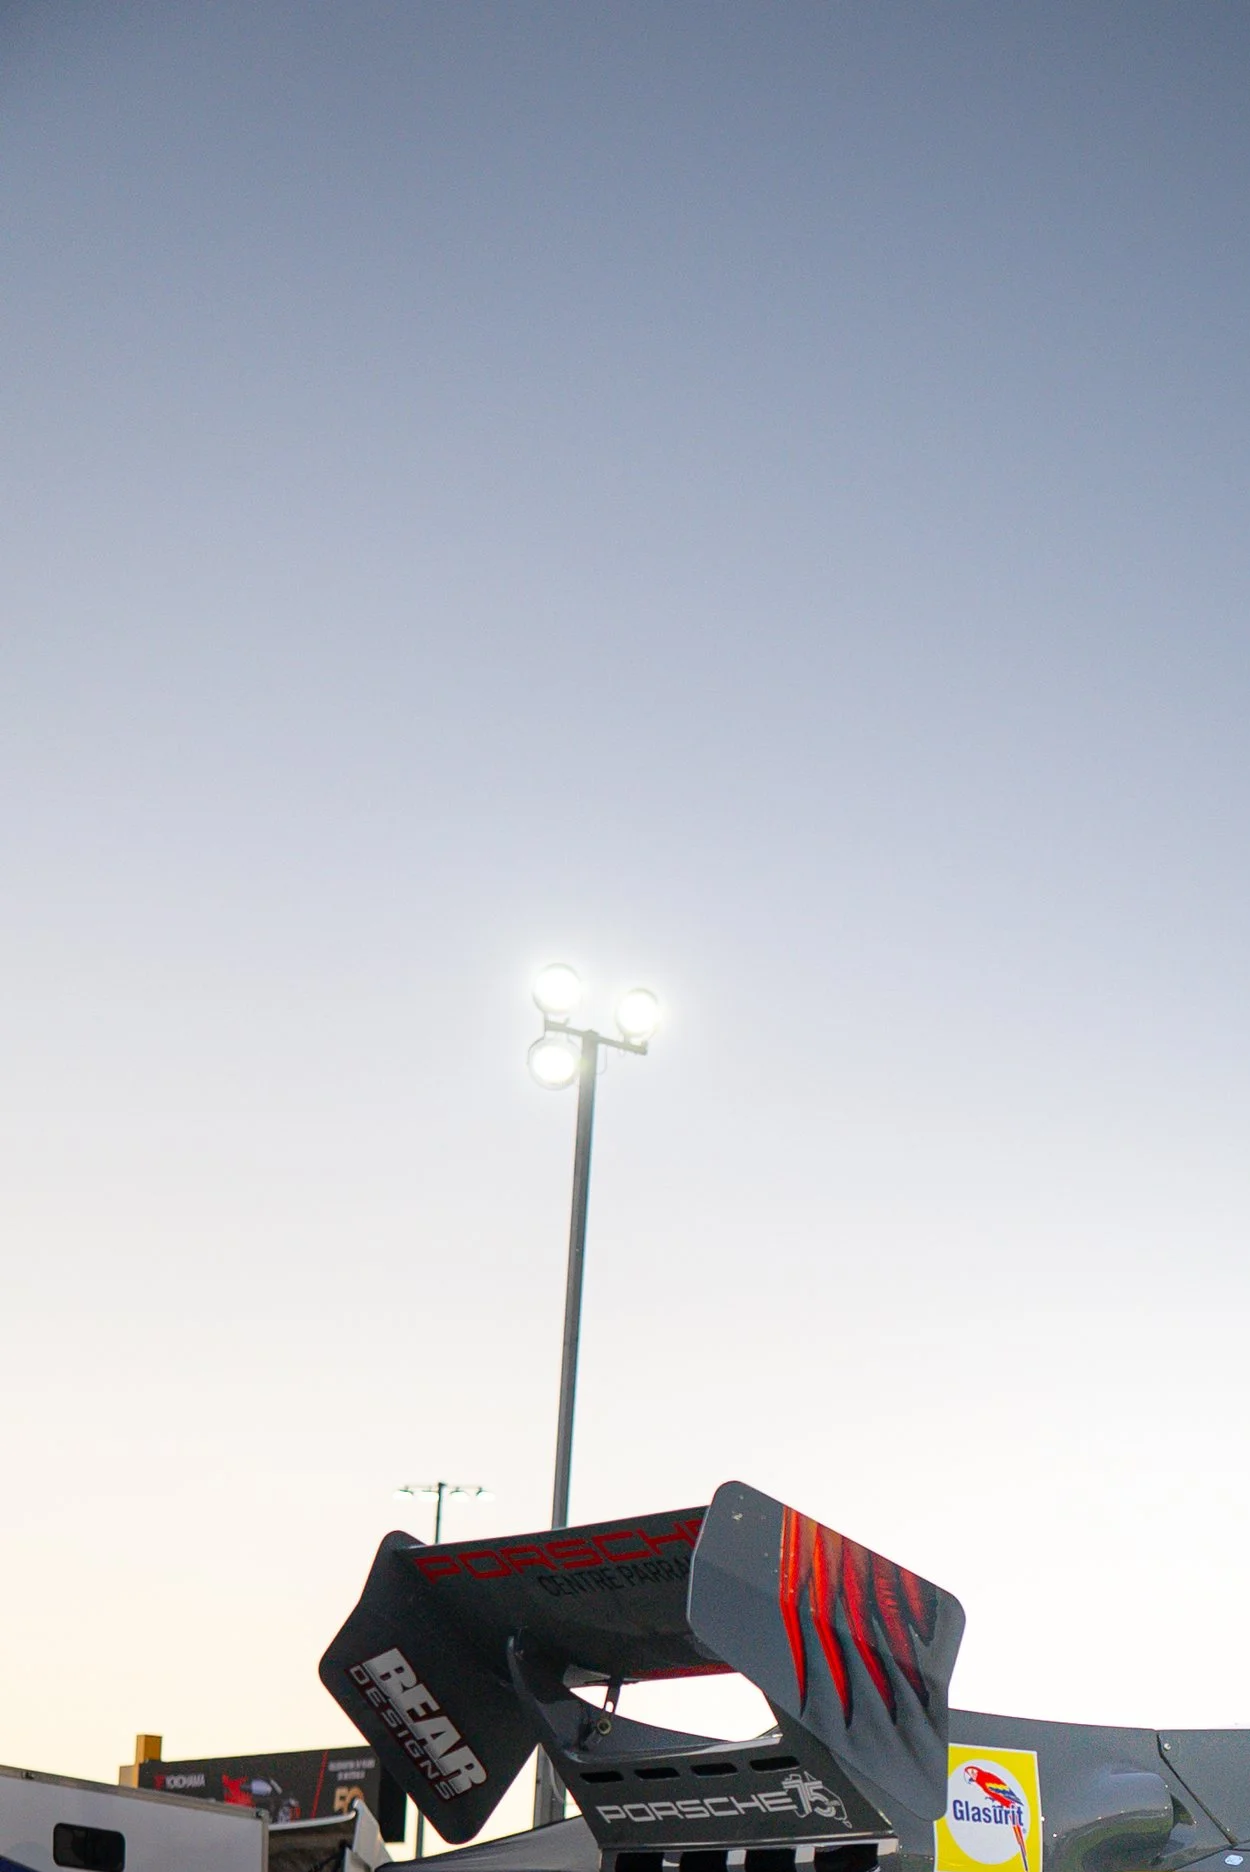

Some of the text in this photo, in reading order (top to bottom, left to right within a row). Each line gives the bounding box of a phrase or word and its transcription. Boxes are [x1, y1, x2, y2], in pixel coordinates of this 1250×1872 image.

[537, 1568, 625, 1597] CENTRE
[349, 1664, 457, 1801] DESIGNS
[362, 1647, 488, 1796] BEAR
[596, 1791, 798, 1824] PORSCHE
[953, 1799, 1024, 1826] Glasurit
